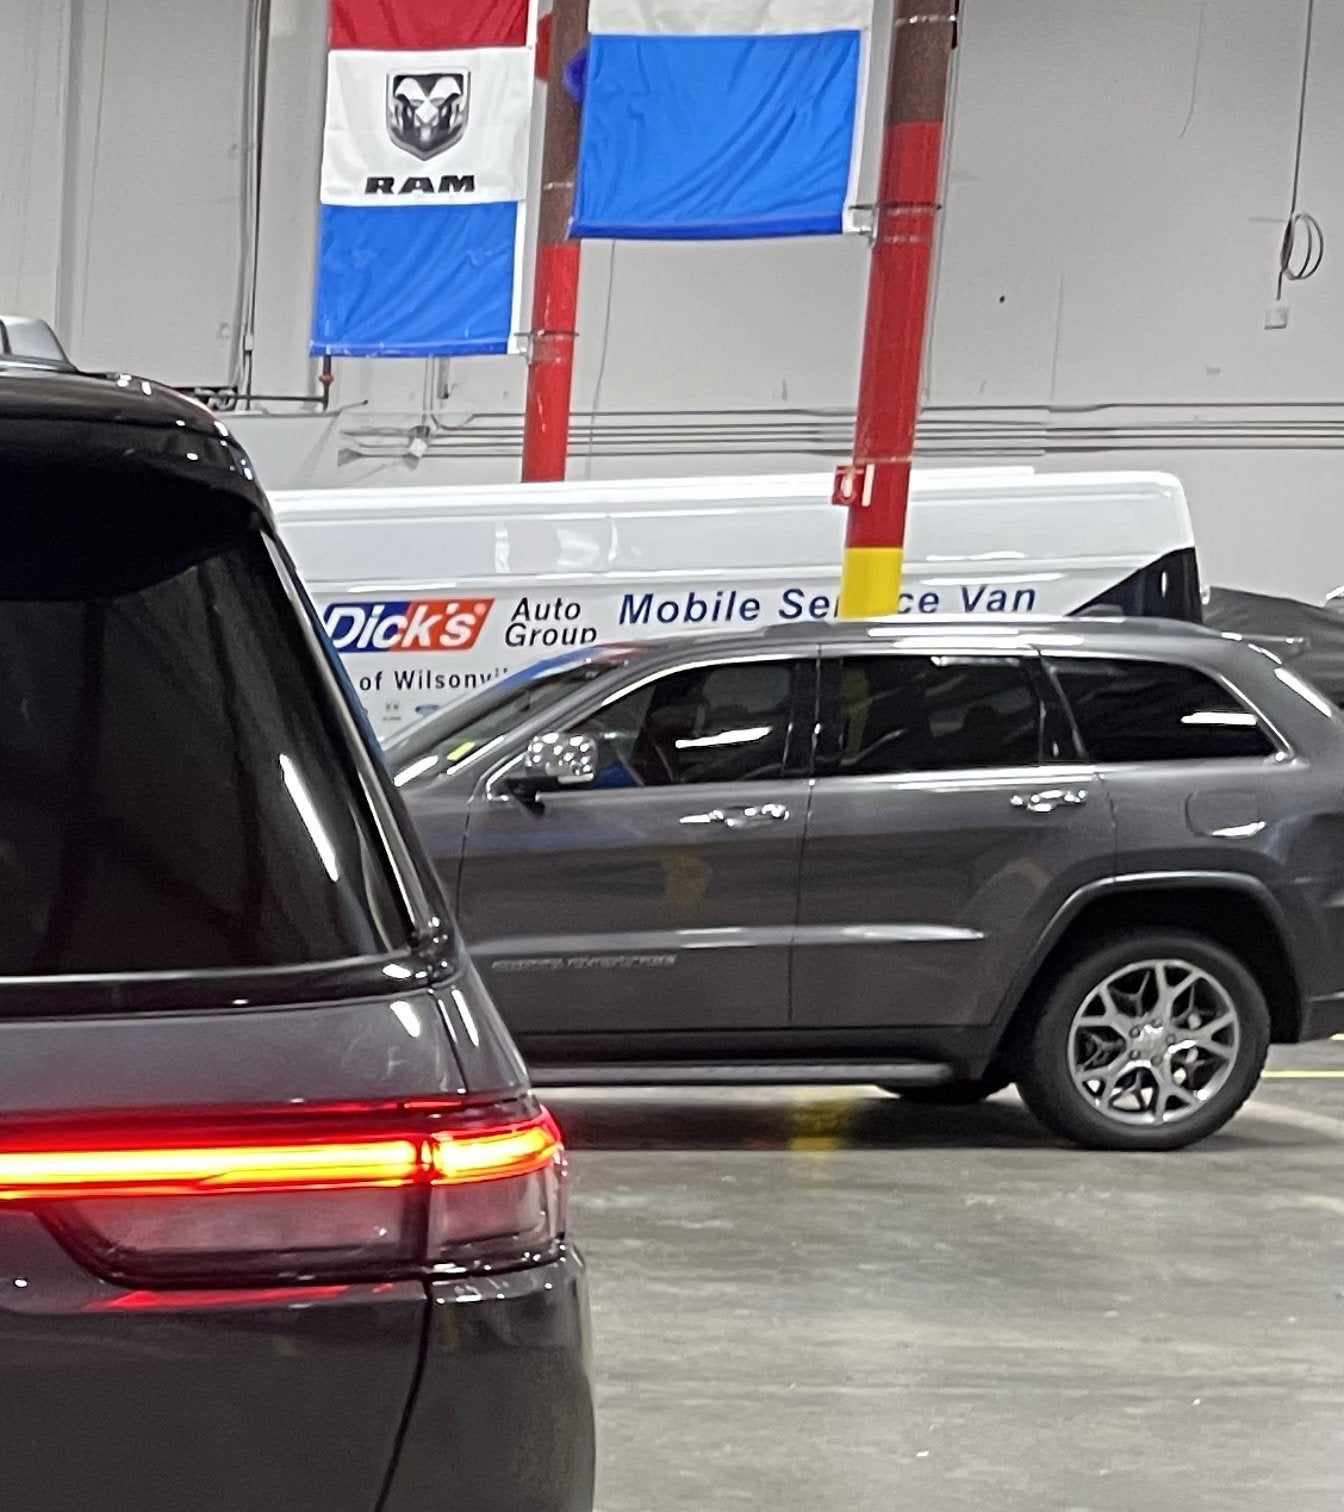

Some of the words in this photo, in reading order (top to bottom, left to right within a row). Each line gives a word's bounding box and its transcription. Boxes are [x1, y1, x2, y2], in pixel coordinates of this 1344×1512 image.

[365, 174, 475, 195] RAM
[510, 597, 582, 621] Auto
[617, 591, 760, 625] Mobile
[778, 588, 940, 620] Sece
[960, 584, 1037, 614] Van
[327, 602, 477, 649] Dick's
[505, 623, 598, 647] Group
[359, 671, 383, 691] of
[394, 667, 510, 690] Wilsonv
